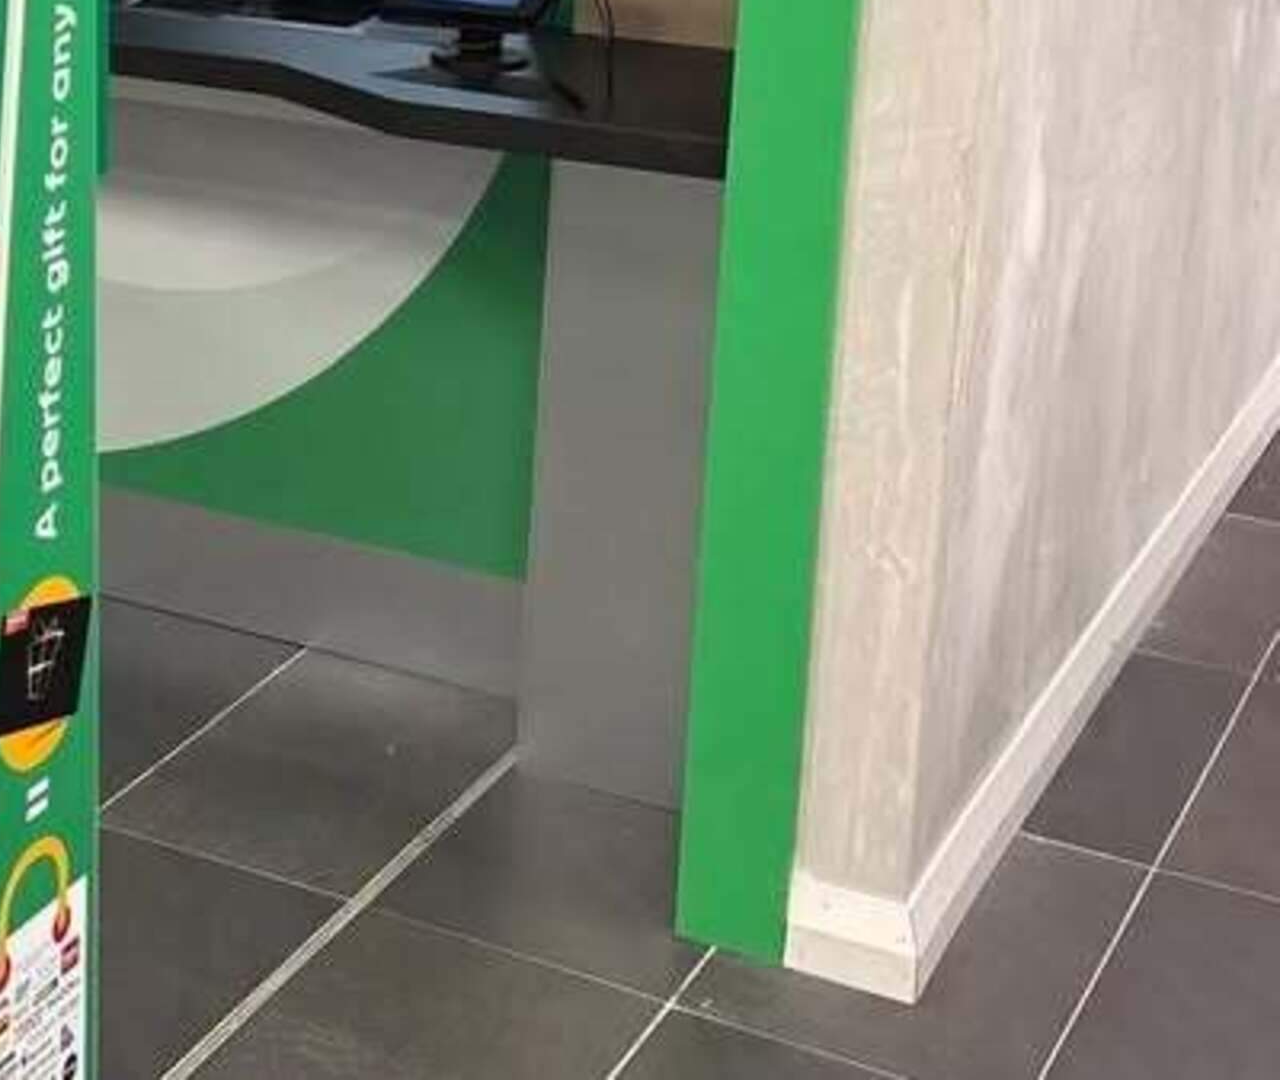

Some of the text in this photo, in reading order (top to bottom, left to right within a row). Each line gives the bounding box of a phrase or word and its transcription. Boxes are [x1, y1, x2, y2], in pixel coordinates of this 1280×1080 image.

[52, 2, 79, 103] any
[44, 116, 70, 193] for
[41, 199, 72, 294] gift
[38, 302, 64, 494] perfect
[34, 502, 58, 540] A
